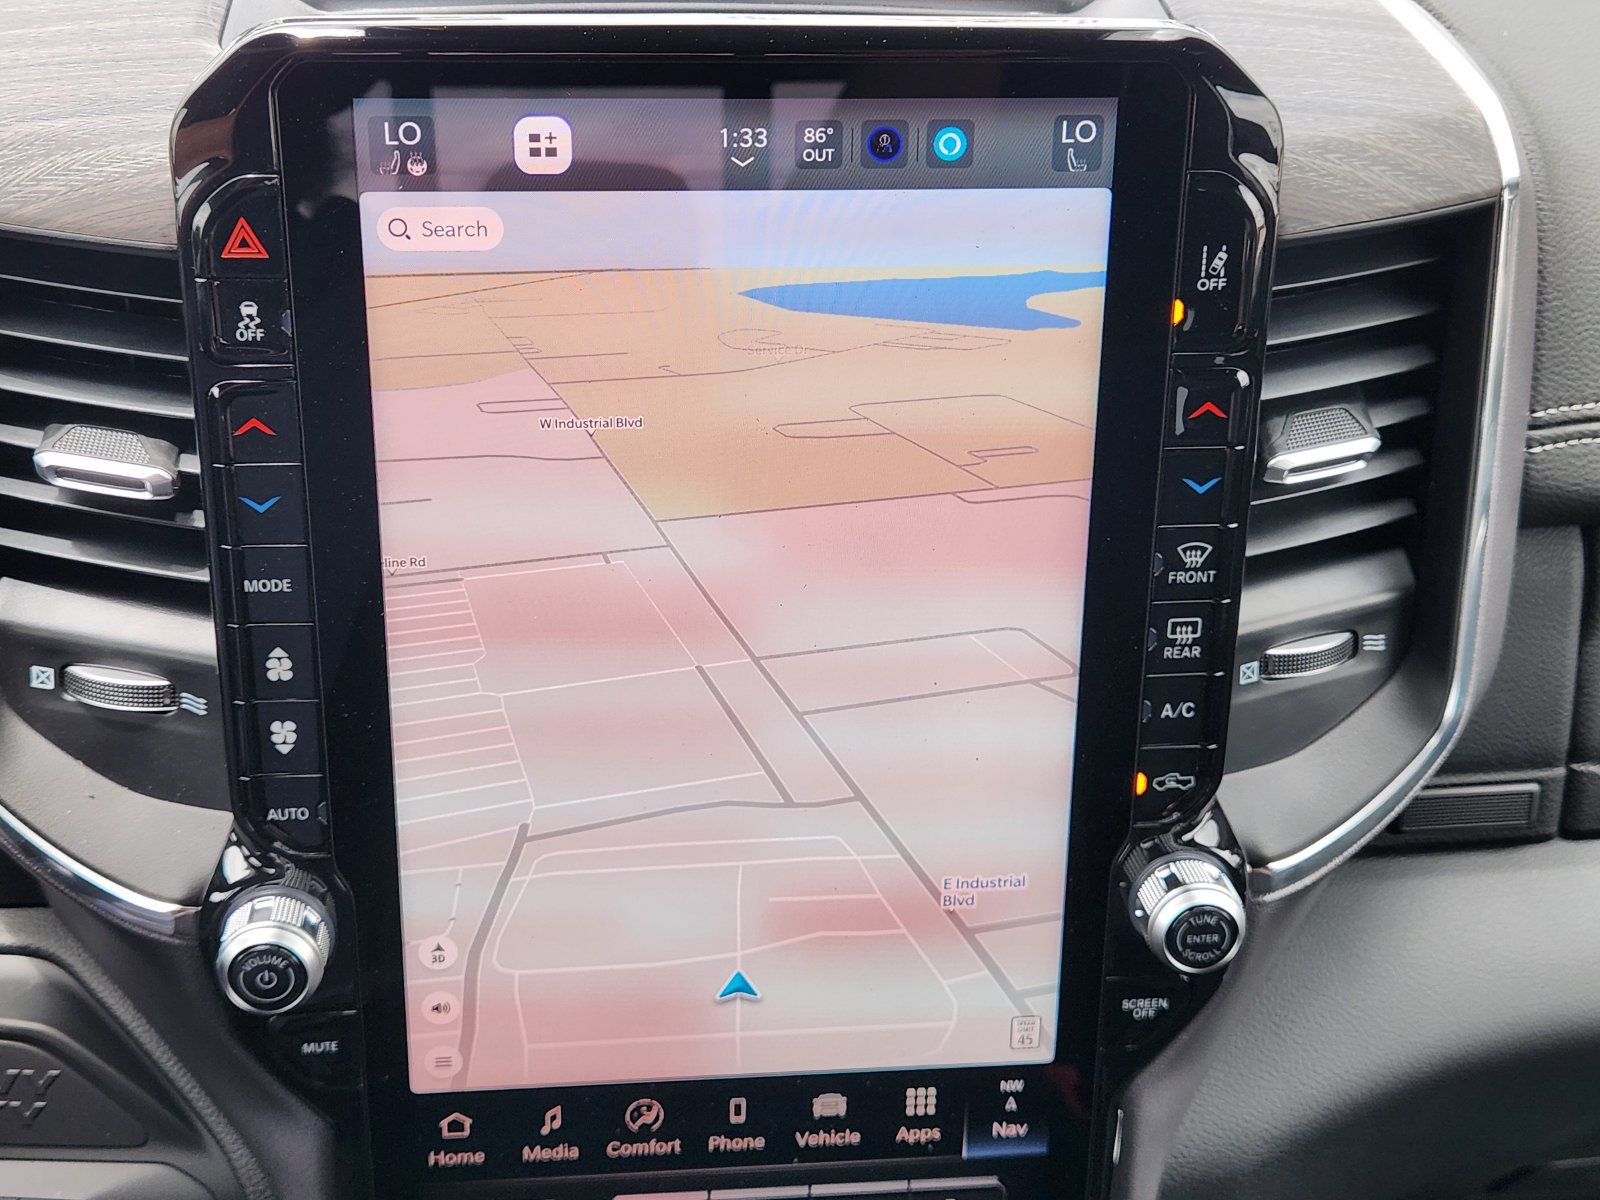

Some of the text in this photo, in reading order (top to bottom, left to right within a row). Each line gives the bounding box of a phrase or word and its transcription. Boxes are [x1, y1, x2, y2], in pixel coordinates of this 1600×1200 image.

[384, 121, 422, 146] LO
[720, 127, 769, 149] 1:33
[803, 127, 834, 143] 86°
[1061, 119, 1097, 144] LO
[802, 148, 836, 163] OUT
[421, 220, 488, 238] Search
[1197, 277, 1228, 291] OFF
[235, 328, 265, 342] OFF
[539, 417, 643, 429] W Industrial Blvd
[409, 557, 426, 567] Rd
[1167, 570, 1217, 584] FRONT
[243, 578, 293, 593] MODE
[1163, 645, 1202, 660] REAR
[1160, 701, 1196, 719] A/C
[266, 806, 310, 821] AUTO
[943, 875, 1026, 890] E Industrial
[942, 894, 975, 907] Blvd
[1189, 913, 1219, 927] TUNE
[1186, 933, 1219, 944] ENTER
[241, 954, 290, 971] VOLUME
[431, 954, 446, 963] 3D
[1182, 948, 1222, 962] SCROLL
[1121, 997, 1170, 1011] SCREEN
[1132, 1007, 1156, 1020] OFF
[1017, 1033, 1033, 1045] 45
[301, 1040, 339, 1055] MUTE
[895, 1125, 942, 1146] Apps
[991, 1121, 1029, 1139] Nav
[708, 1134, 766, 1153] Phone
[795, 1128, 861, 1148] Vehicle
[522, 1143, 580, 1163] Media
[606, 1138, 682, 1158] Comfort
[428, 1150, 486, 1168] Home
